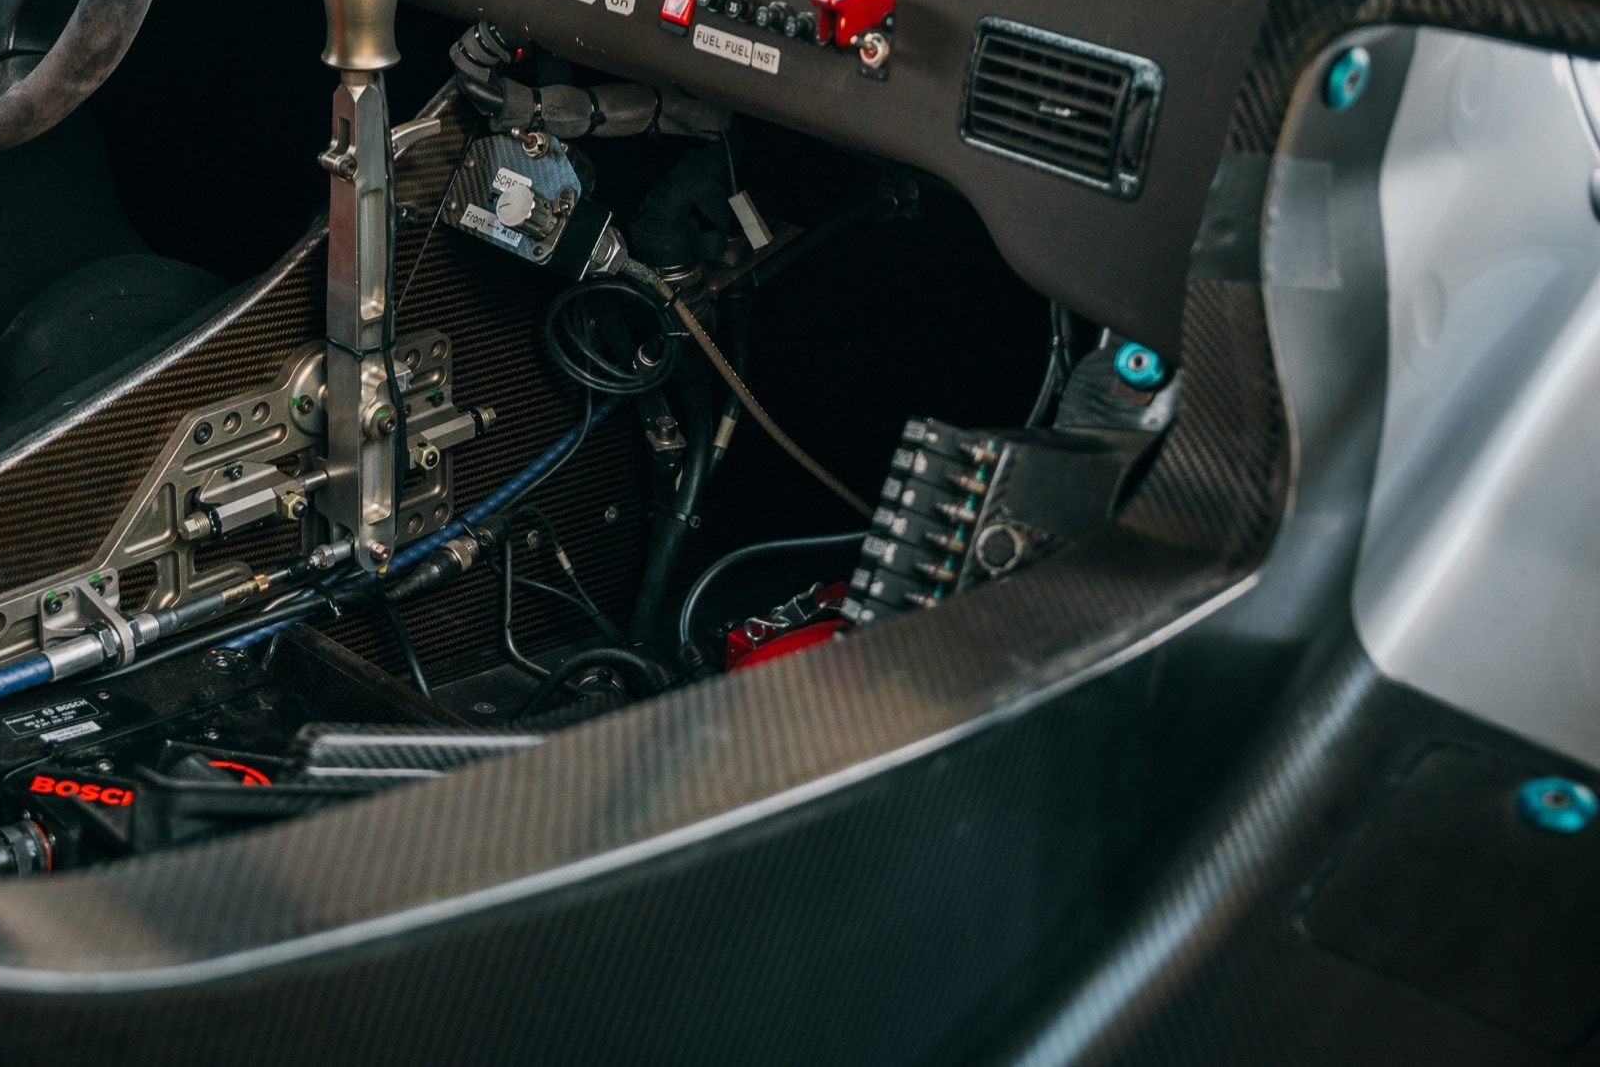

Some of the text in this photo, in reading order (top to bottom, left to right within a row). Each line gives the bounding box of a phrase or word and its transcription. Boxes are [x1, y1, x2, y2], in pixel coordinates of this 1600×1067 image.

[728, 1, 738, 13] 35
[696, 30, 777, 65] FUEL FUEL INST
[464, 210, 486, 227] Front
[55, 699, 88, 713] BOSCH
